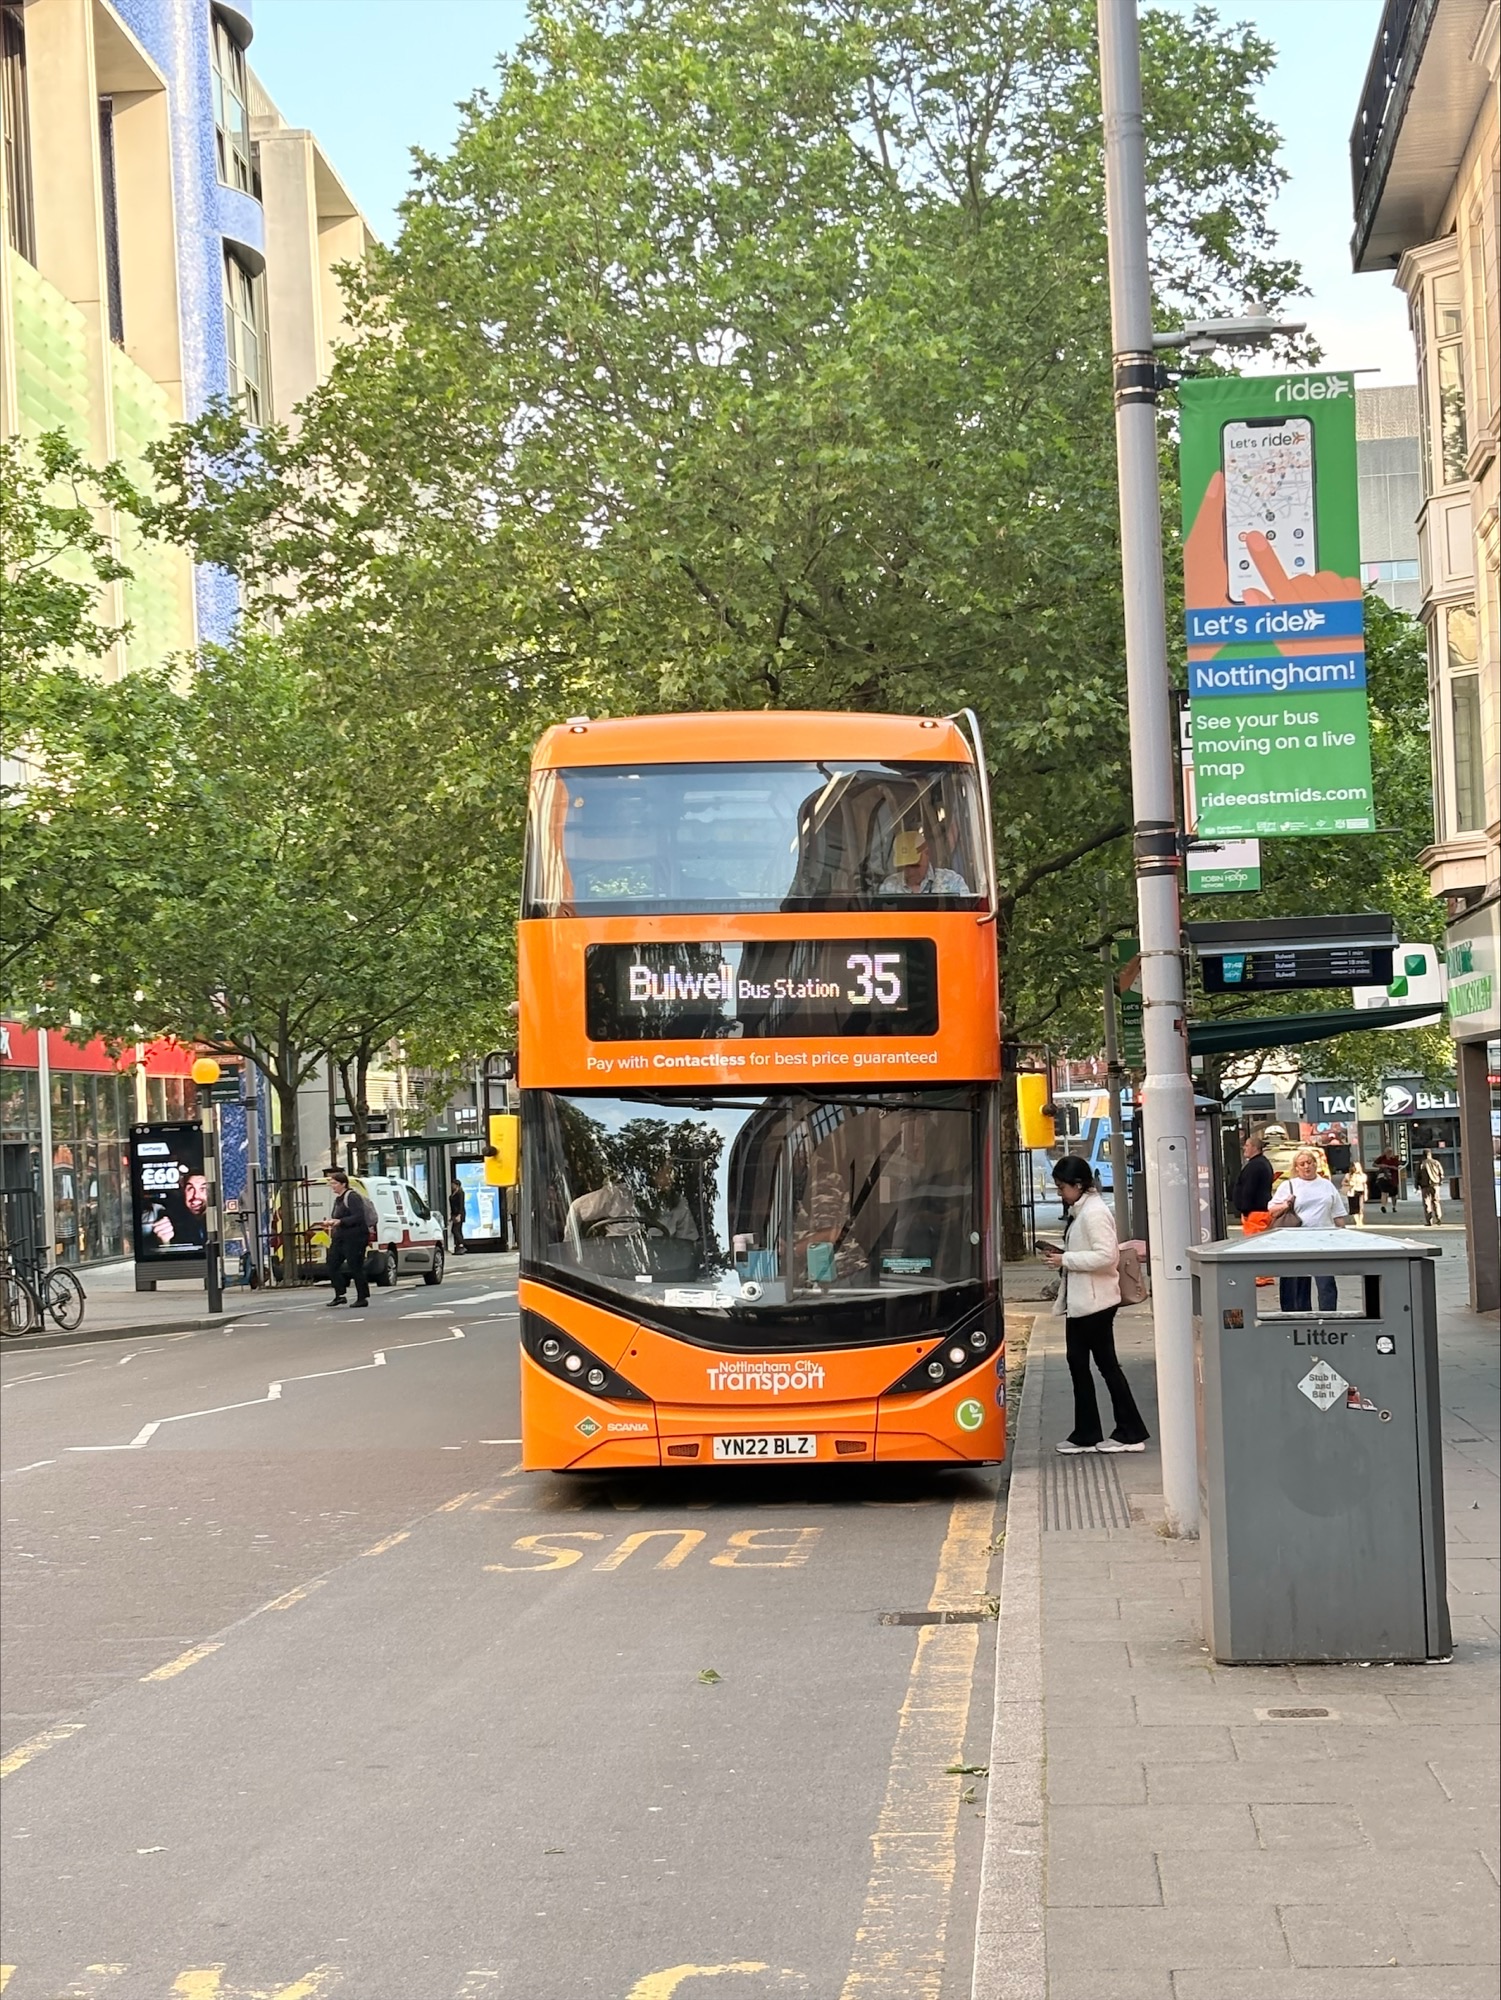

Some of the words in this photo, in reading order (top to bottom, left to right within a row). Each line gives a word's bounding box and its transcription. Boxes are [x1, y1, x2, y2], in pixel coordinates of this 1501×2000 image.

[1275, 377, 1327, 402] ride
[1230, 438, 1257, 449] Let's
[1261, 432, 1292, 447] ride
[1193, 615, 1248, 637] Let's
[1255, 610, 1304, 634] ride
[1196, 660, 1356, 691] Nottingham!
[1196, 715, 1231, 730] See
[1235, 713, 1279, 733] your
[1283, 710, 1319, 726] bus
[1198, 735, 1270, 755] moving
[1275, 736, 1300, 750] on
[1304, 734, 1318, 748] a
[1322, 730, 1355, 747] live
[1199, 762, 1245, 780] map
[1201, 787, 1367, 808] rideeastmids.com
[629, 964, 734, 1001] Bulwell
[738, 979, 771, 999] Bus
[774, 978, 840, 999] Station
[846, 954, 901, 1005] 35
[586, 1057, 614, 1073] Pay
[618, 1055, 649, 1069] with
[653, 1053, 746, 1067] Contactless
[749, 1052, 771, 1065] for
[775, 1052, 808, 1065] best
[811, 1051, 849, 1067] price
[853, 1051, 938, 1067] guaranteed
[1318, 1096, 1356, 1114] TAC
[141, 1167, 180, 1185] £60
[1293, 1329, 1348, 1346] Litter
[719, 1361, 792, 1375] Nottingham
[795, 1360, 819, 1374] City
[706, 1366, 826, 1396] Transport
[1309, 1374, 1329, 1382] Stub
[1315, 1382, 1332, 1390] and
[1312, 1391, 1327, 1399] Bin
[607, 1423, 649, 1432] SCANIA
[721, 1438, 769, 1456] YN22
[774, 1437, 809, 1455] BLZ
[482, 1527, 825, 1573] BUS
